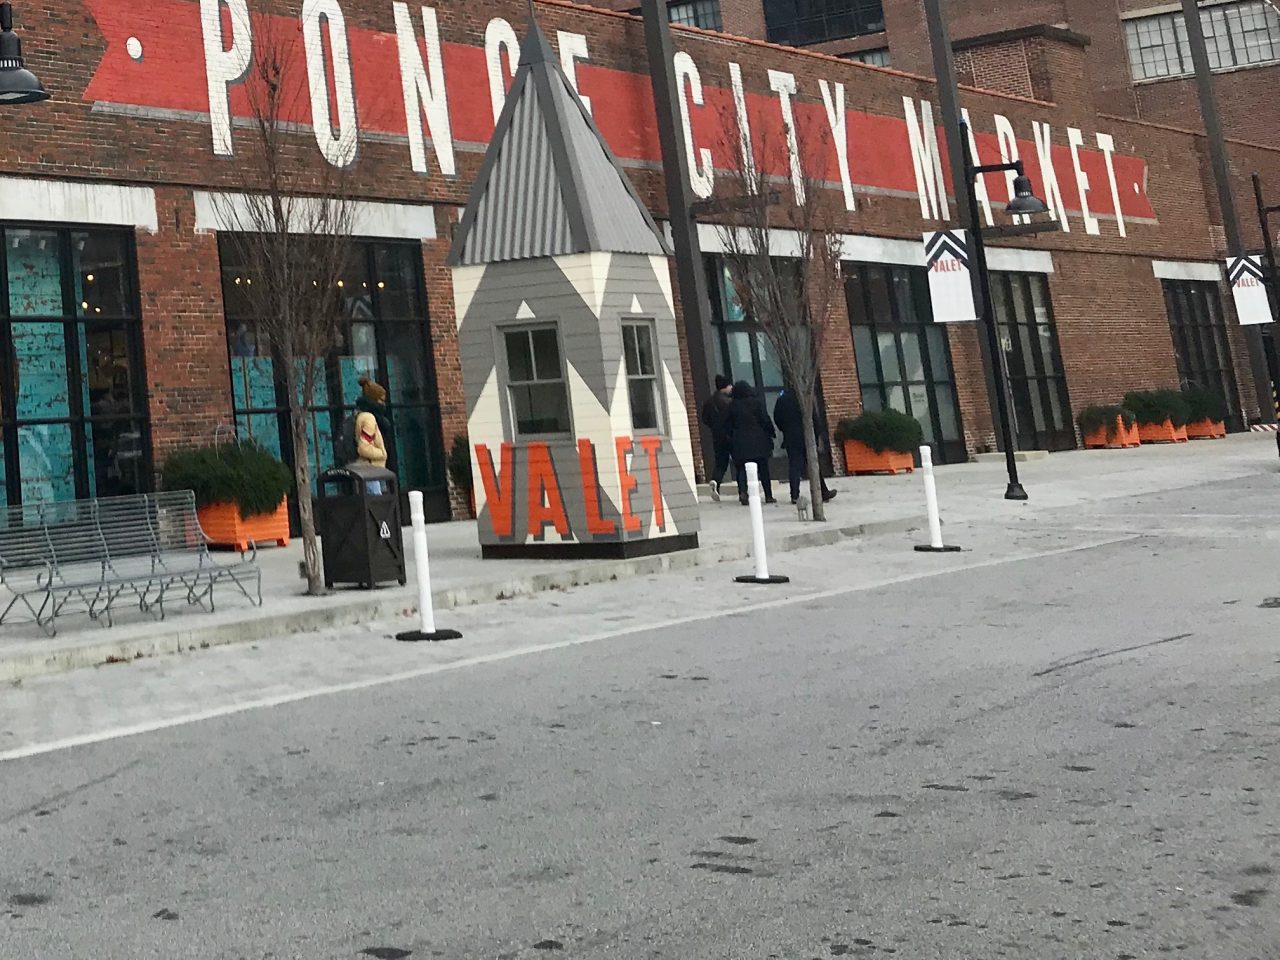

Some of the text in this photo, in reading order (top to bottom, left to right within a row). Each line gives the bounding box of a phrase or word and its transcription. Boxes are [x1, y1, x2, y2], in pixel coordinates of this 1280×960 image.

[673, 50, 856, 212] CITY
[932, 258, 962, 273] VALET
[474, 435, 666, 538] VALET
